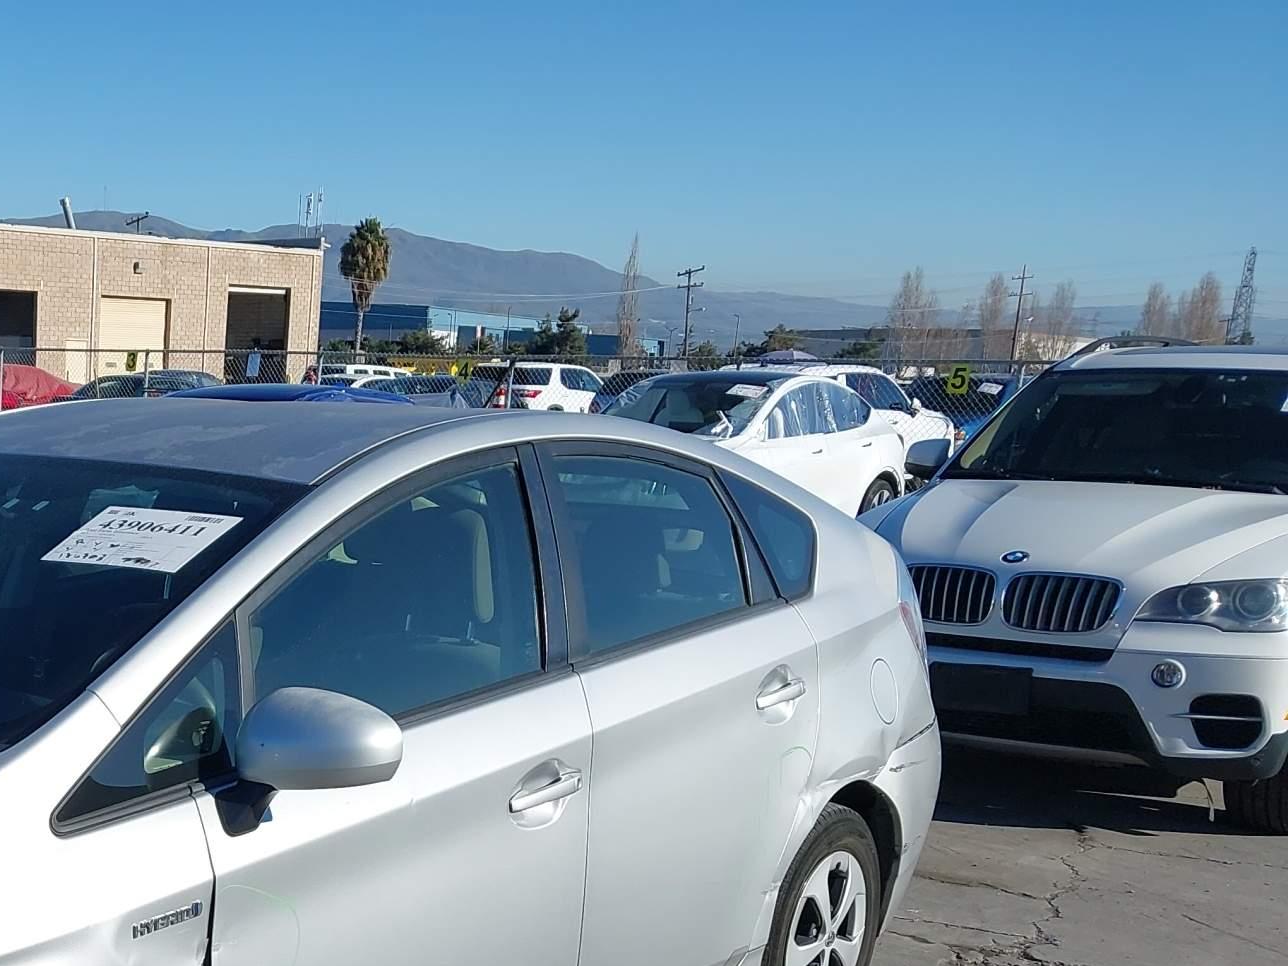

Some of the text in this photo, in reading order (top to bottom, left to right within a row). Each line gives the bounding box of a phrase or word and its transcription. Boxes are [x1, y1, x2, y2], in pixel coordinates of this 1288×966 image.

[128, 353, 135, 368] 3
[458, 362, 469, 380] 4
[951, 367, 967, 389] 5
[99, 517, 208, 536] 43906411
[132, 905, 196, 939] HYBRID
